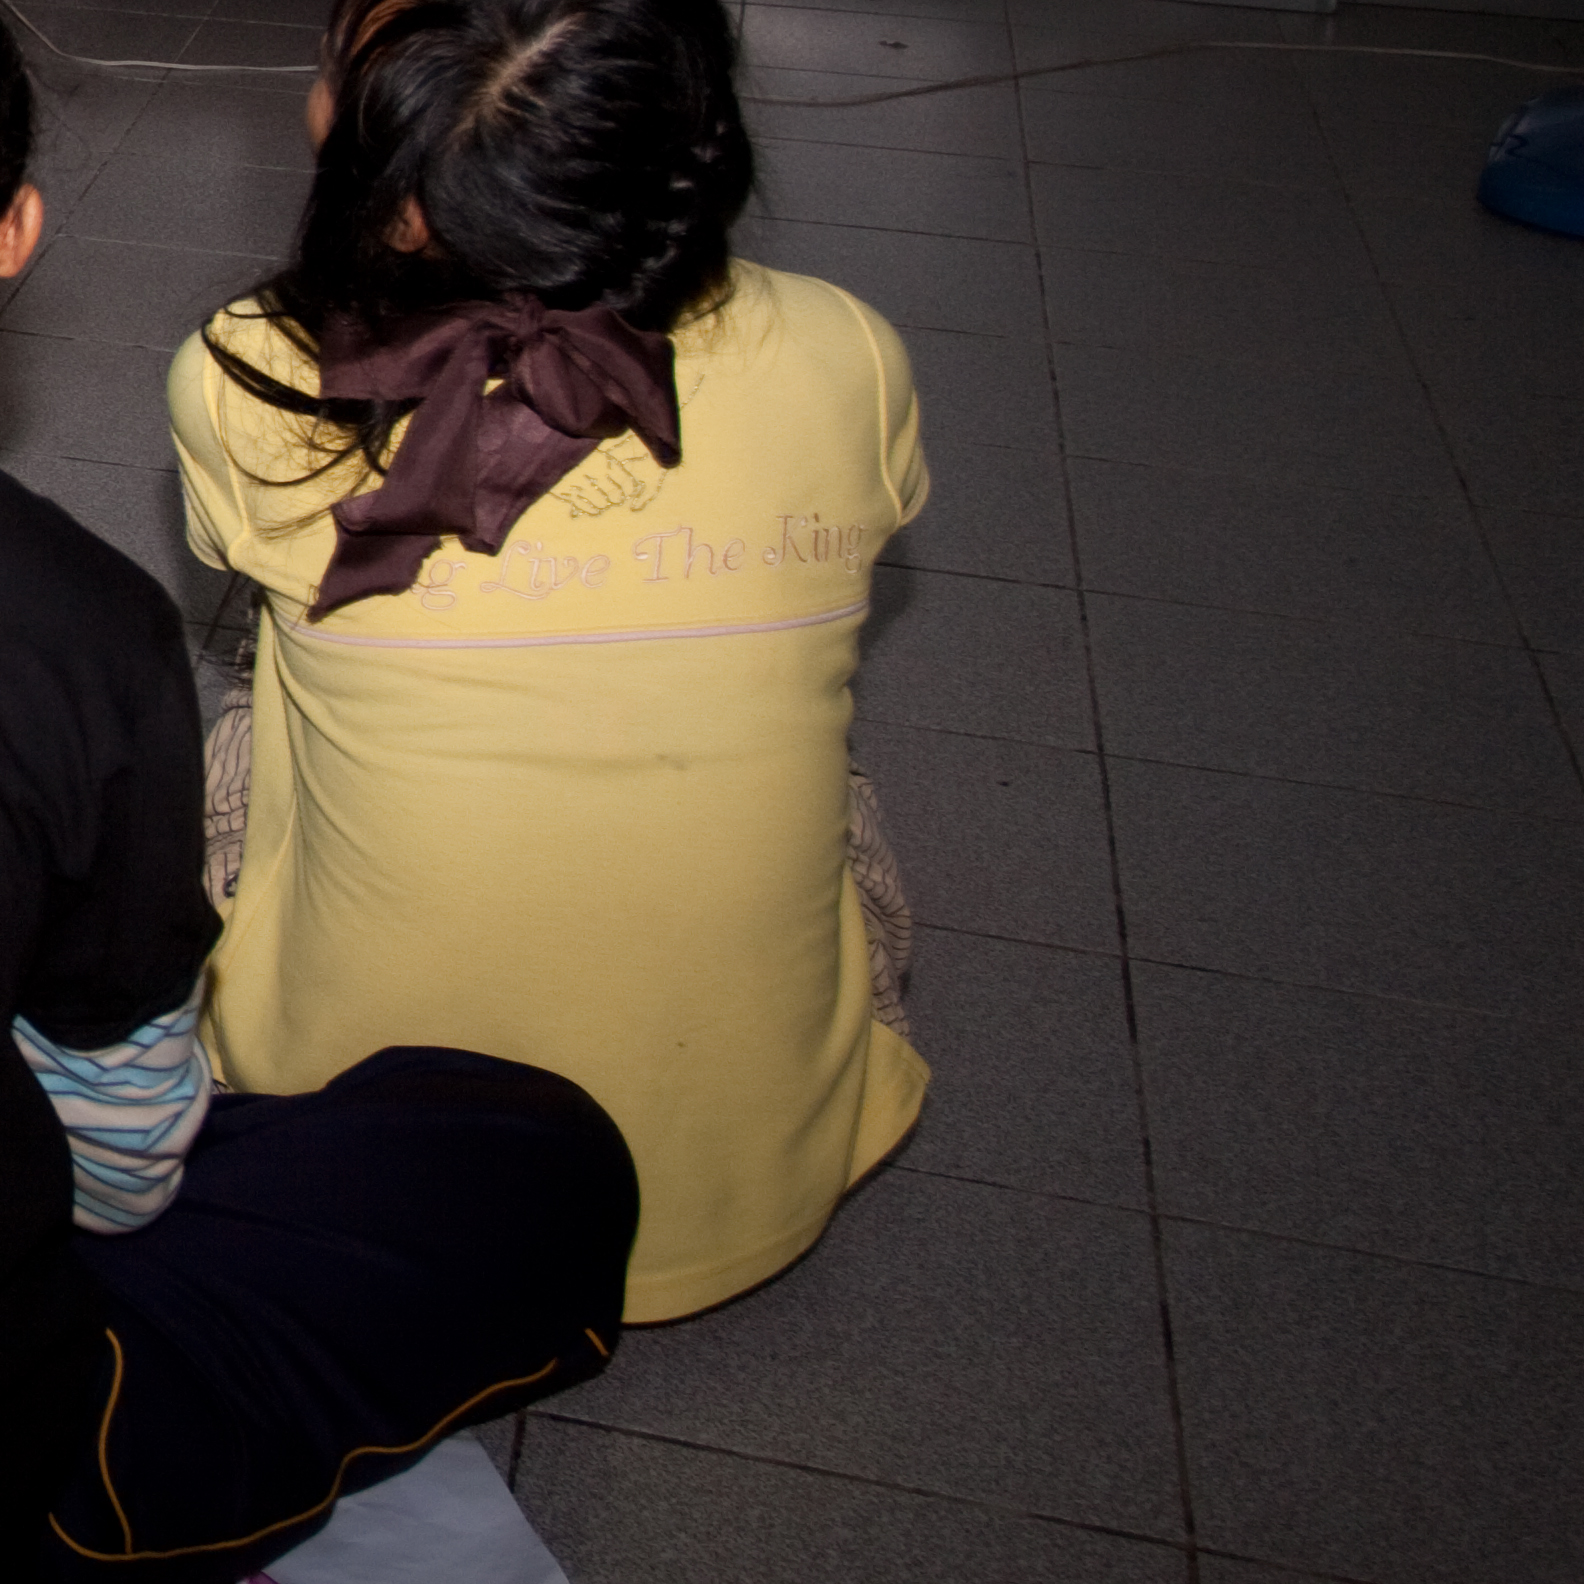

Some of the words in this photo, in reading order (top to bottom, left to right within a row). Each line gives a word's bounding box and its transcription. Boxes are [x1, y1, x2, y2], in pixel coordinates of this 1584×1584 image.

[479, 539, 611, 601] Live
[633, 524, 747, 584] The
[762, 512, 869, 574] King
